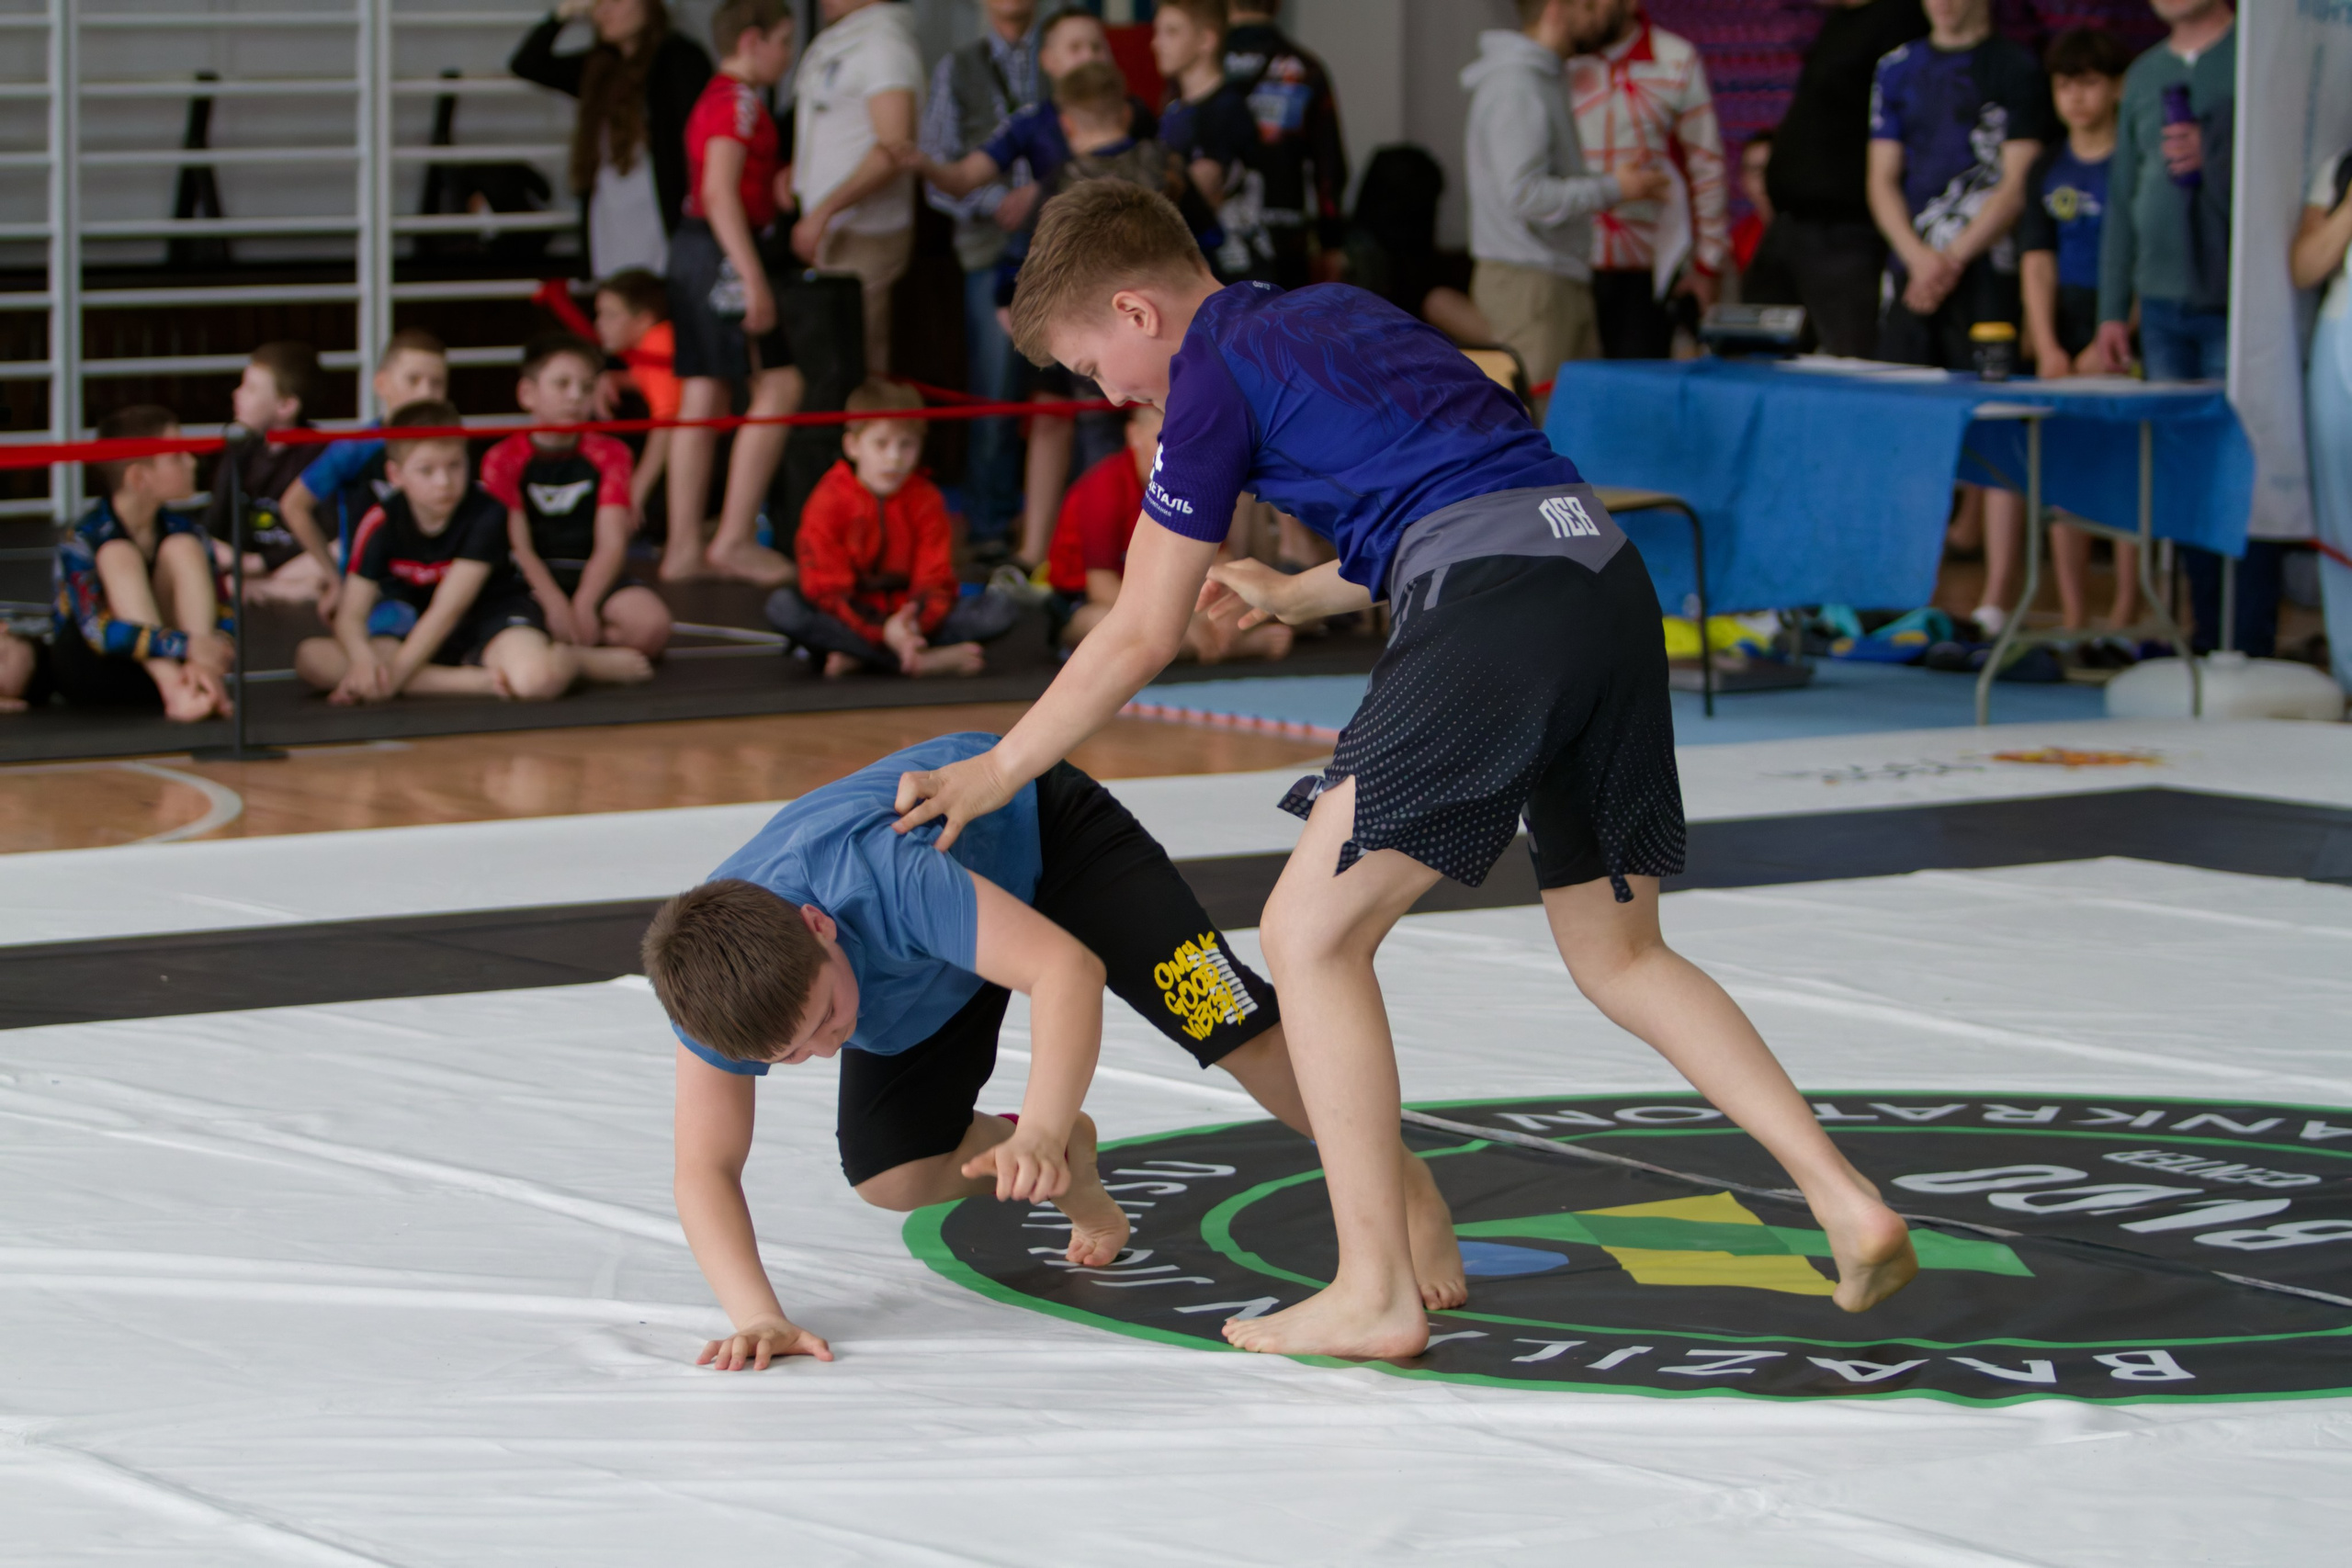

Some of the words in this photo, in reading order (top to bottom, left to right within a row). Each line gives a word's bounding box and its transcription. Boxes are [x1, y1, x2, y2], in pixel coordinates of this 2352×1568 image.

[1164, 963, 1220, 1018] GOOD
[1494, 1102, 2352, 1140] ANKRATON
[2102, 1149, 2322, 1189] CENTER
